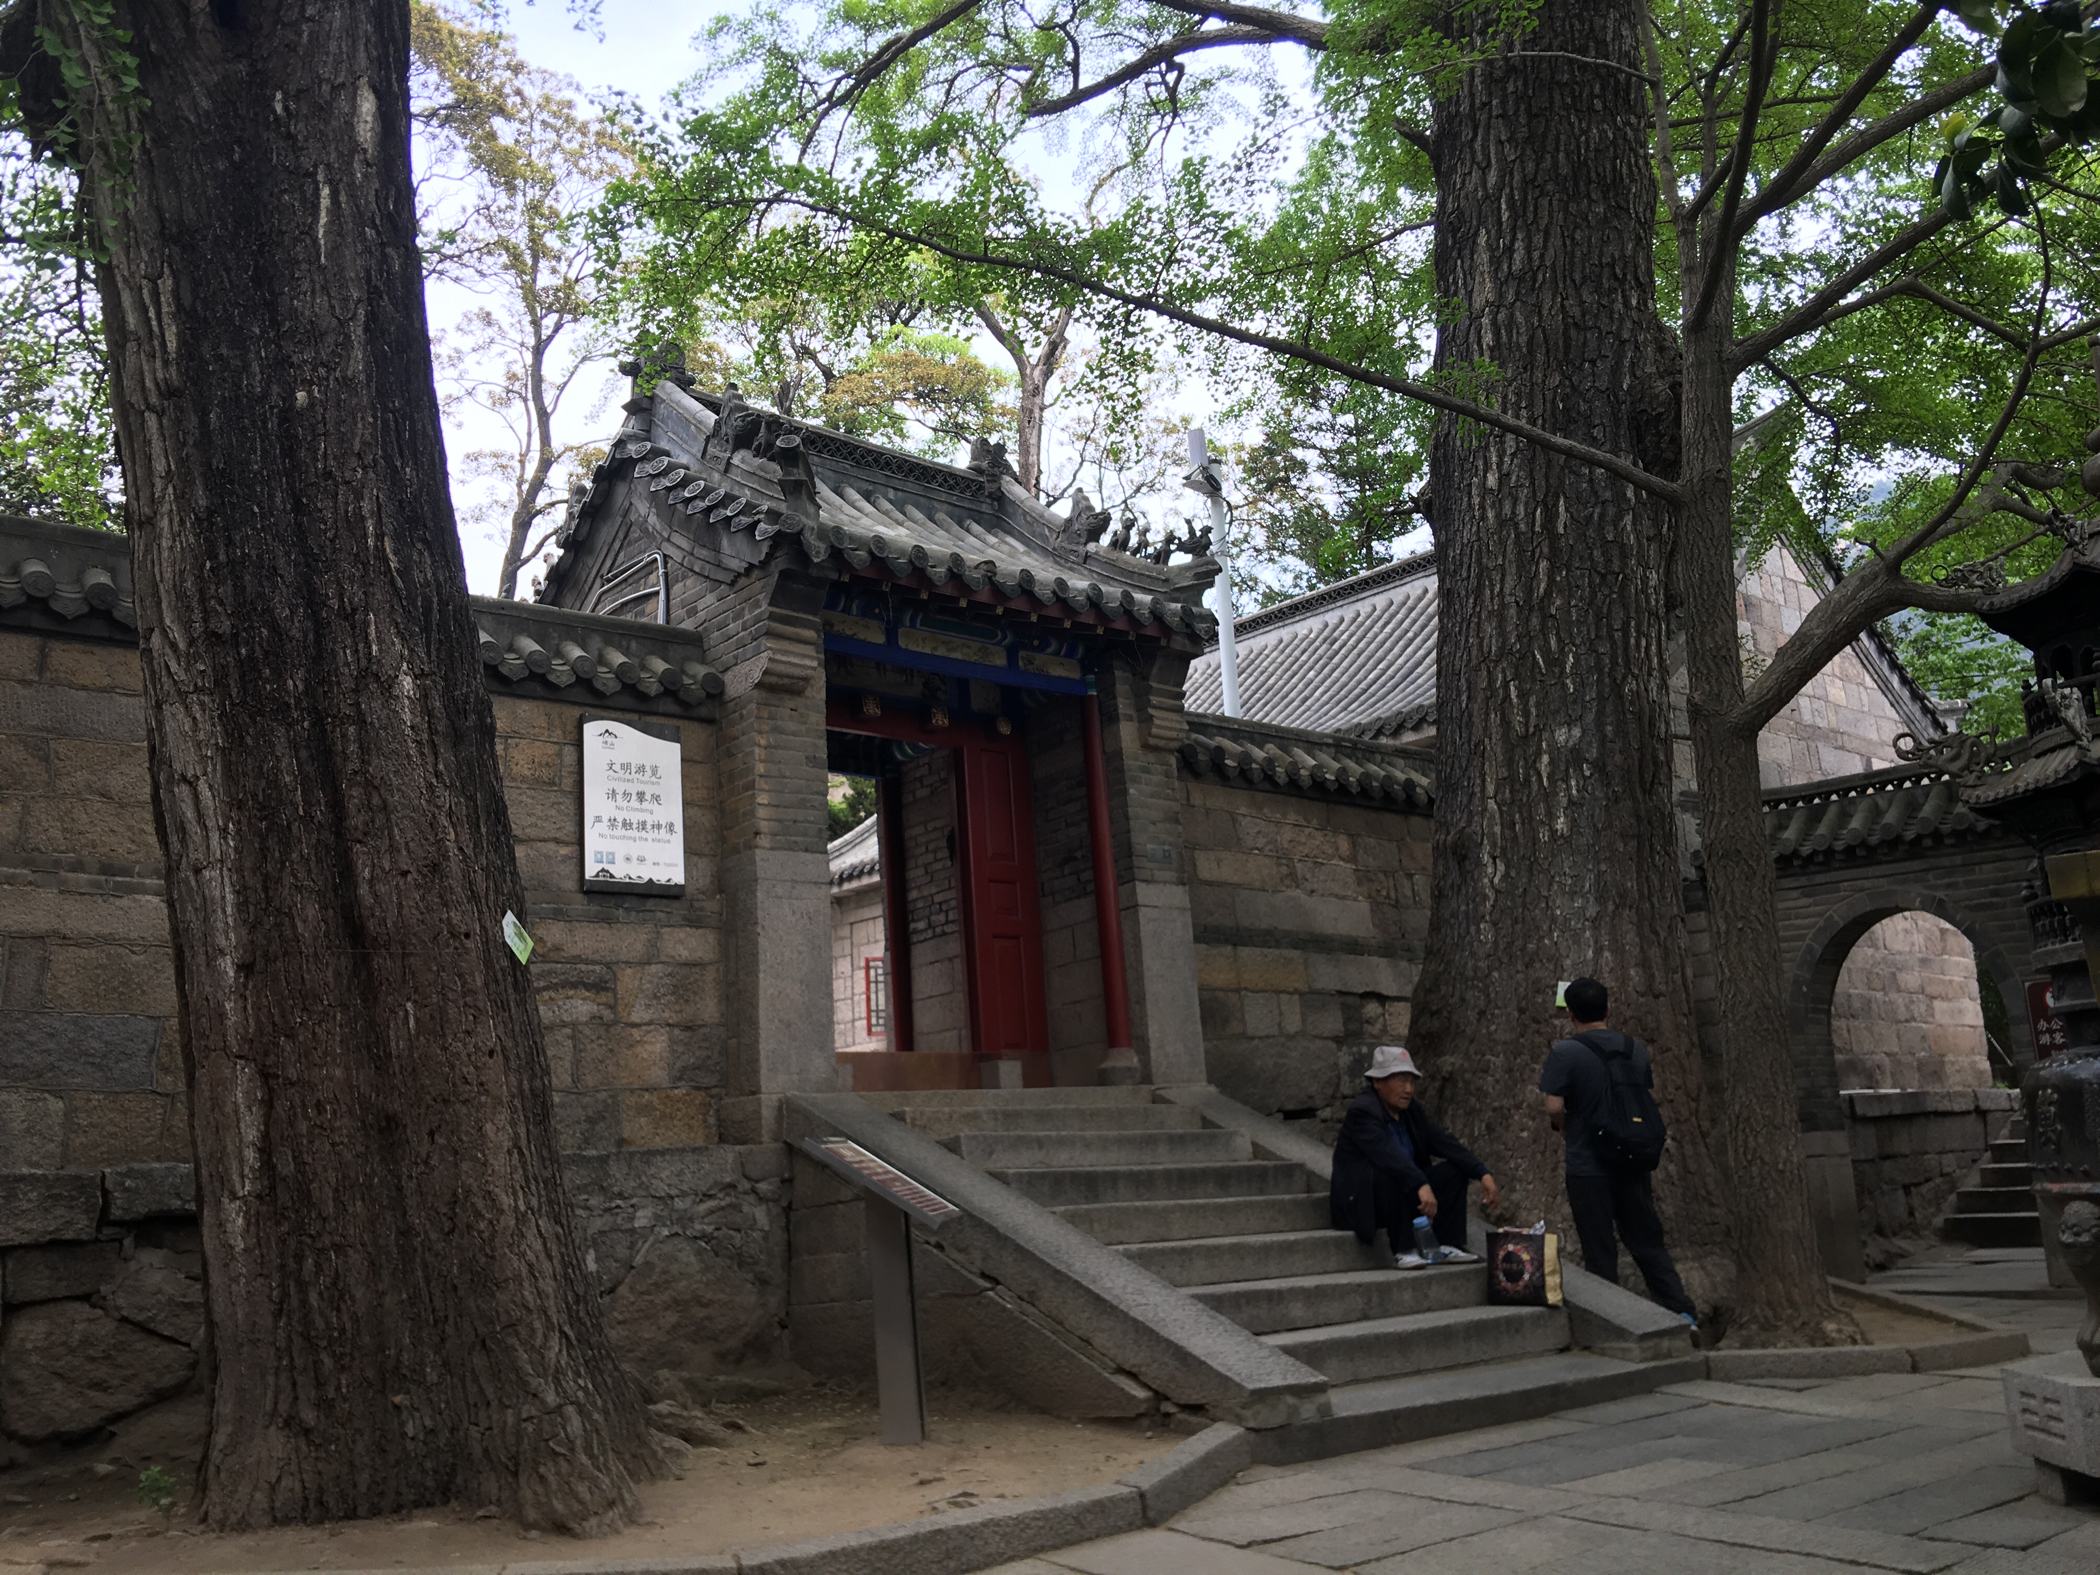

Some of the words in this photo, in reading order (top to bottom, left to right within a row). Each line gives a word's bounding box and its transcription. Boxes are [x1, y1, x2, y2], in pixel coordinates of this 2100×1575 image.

[605, 759, 662, 779] 文明游览
[607, 775, 634, 783] Civilized
[636, 778, 660, 786] Tourism
[605, 787, 663, 805] 请勿攀爬
[626, 806, 654, 815] Climbing
[590, 815, 678, 835] 严禁触摸神像
[609, 834, 637, 842] touching
